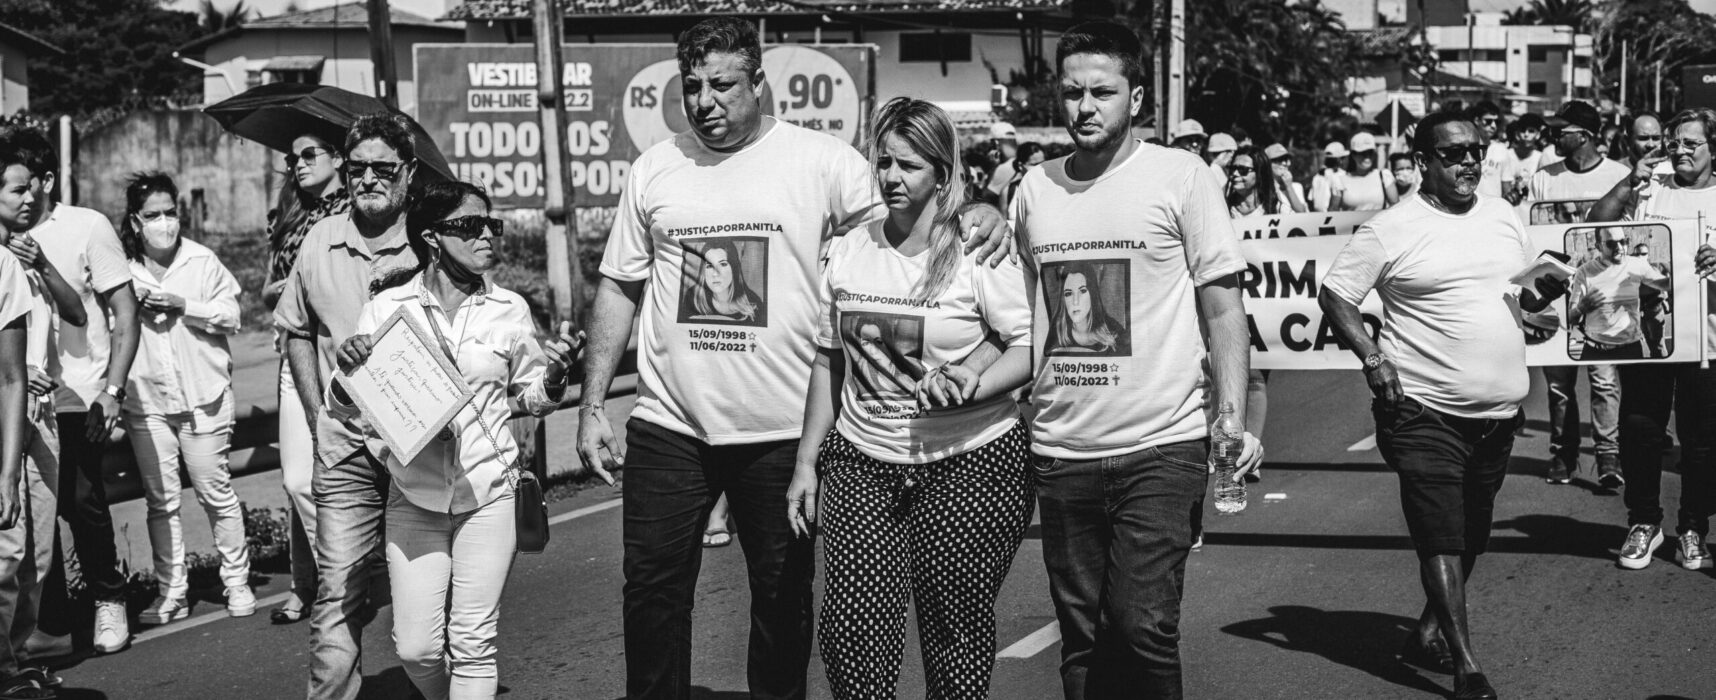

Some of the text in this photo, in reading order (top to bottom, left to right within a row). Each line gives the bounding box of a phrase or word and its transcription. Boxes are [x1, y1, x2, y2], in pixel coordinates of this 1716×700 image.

[468, 63, 593, 86] VESTIBAR
[471, 92, 532, 108] ON-LINE
[630, 85, 658, 110] R$
[450, 121, 610, 158] TODO OS
[449, 161, 545, 197] URSO
[667, 222, 783, 237] #JUSTIÇAPORRANITLA
[1239, 259, 1317, 299] RIM
[688, 328, 747, 341] 15/09/1998
[690, 341, 747, 352] 11/06/2022
[1052, 362, 1109, 375] 15/09/1998
[1054, 375, 1109, 387] 11/06/2022
